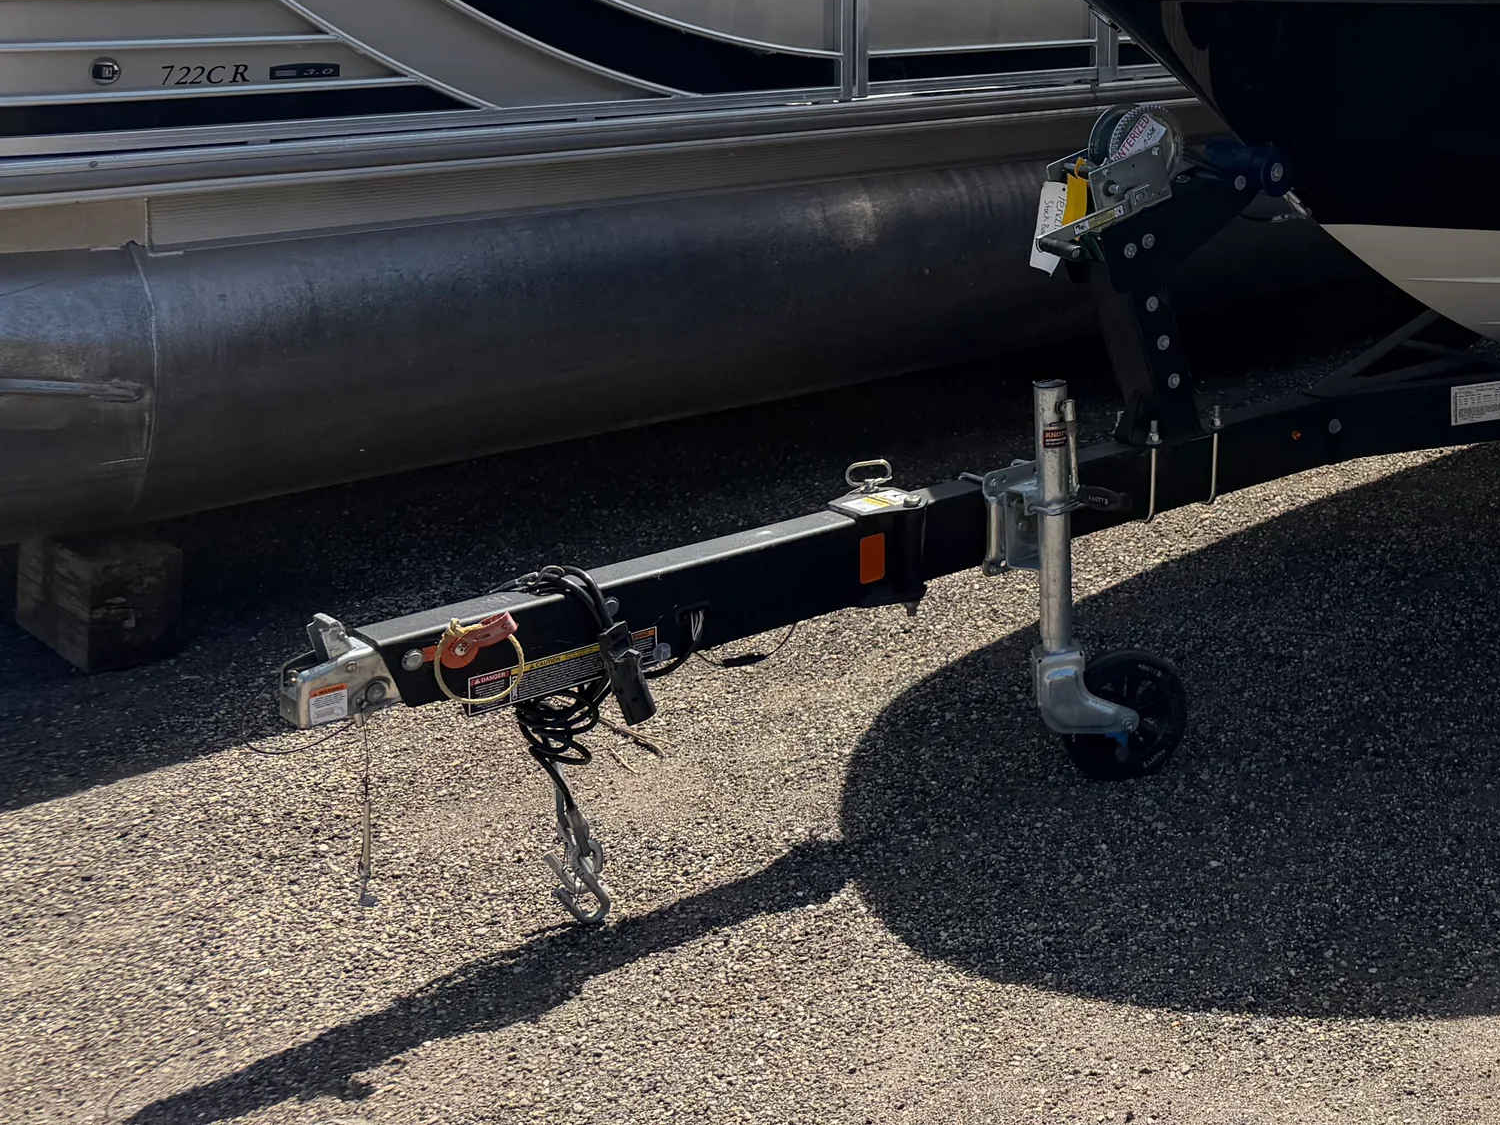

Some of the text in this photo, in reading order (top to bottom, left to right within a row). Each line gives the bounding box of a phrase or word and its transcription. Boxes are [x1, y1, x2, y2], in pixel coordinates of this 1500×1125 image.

[303, 68, 334, 77] 3.0
[535, 657, 562, 667] CAUTION
[480, 671, 506, 683] DANGER
